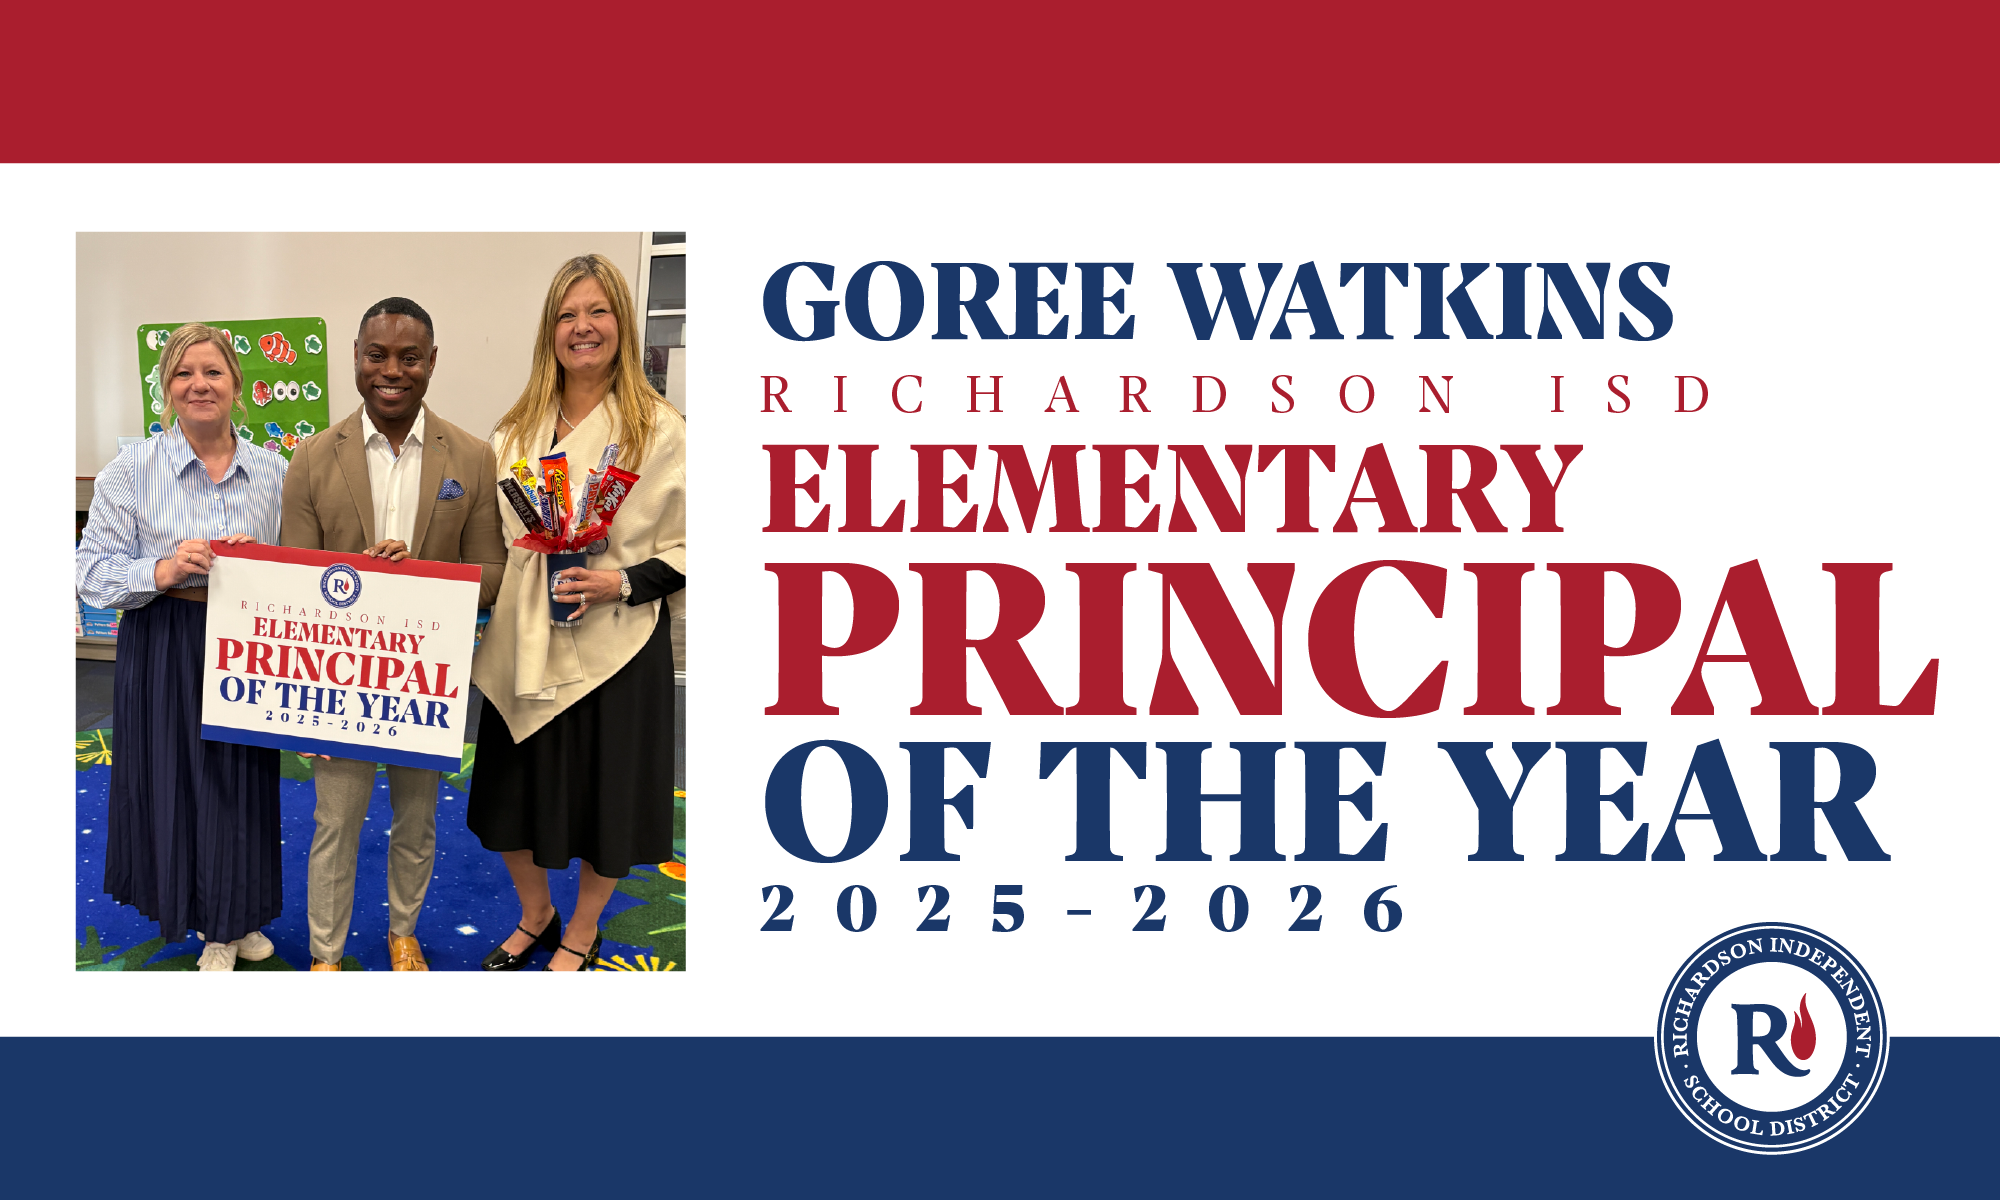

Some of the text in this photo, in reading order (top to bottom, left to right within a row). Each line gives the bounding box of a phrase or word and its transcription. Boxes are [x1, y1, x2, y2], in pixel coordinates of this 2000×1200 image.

[503, 480, 536, 523] HERSHEY'S
[333, 578, 347, 594] R
[241, 600, 440, 631] RICHARDSON ISD
[253, 616, 425, 655] ELEMENTARY
[215, 637, 459, 699] PRINCIPAL
[219, 676, 450, 729] OF THE YEAR
[265, 710, 397, 737] 2025-2026
